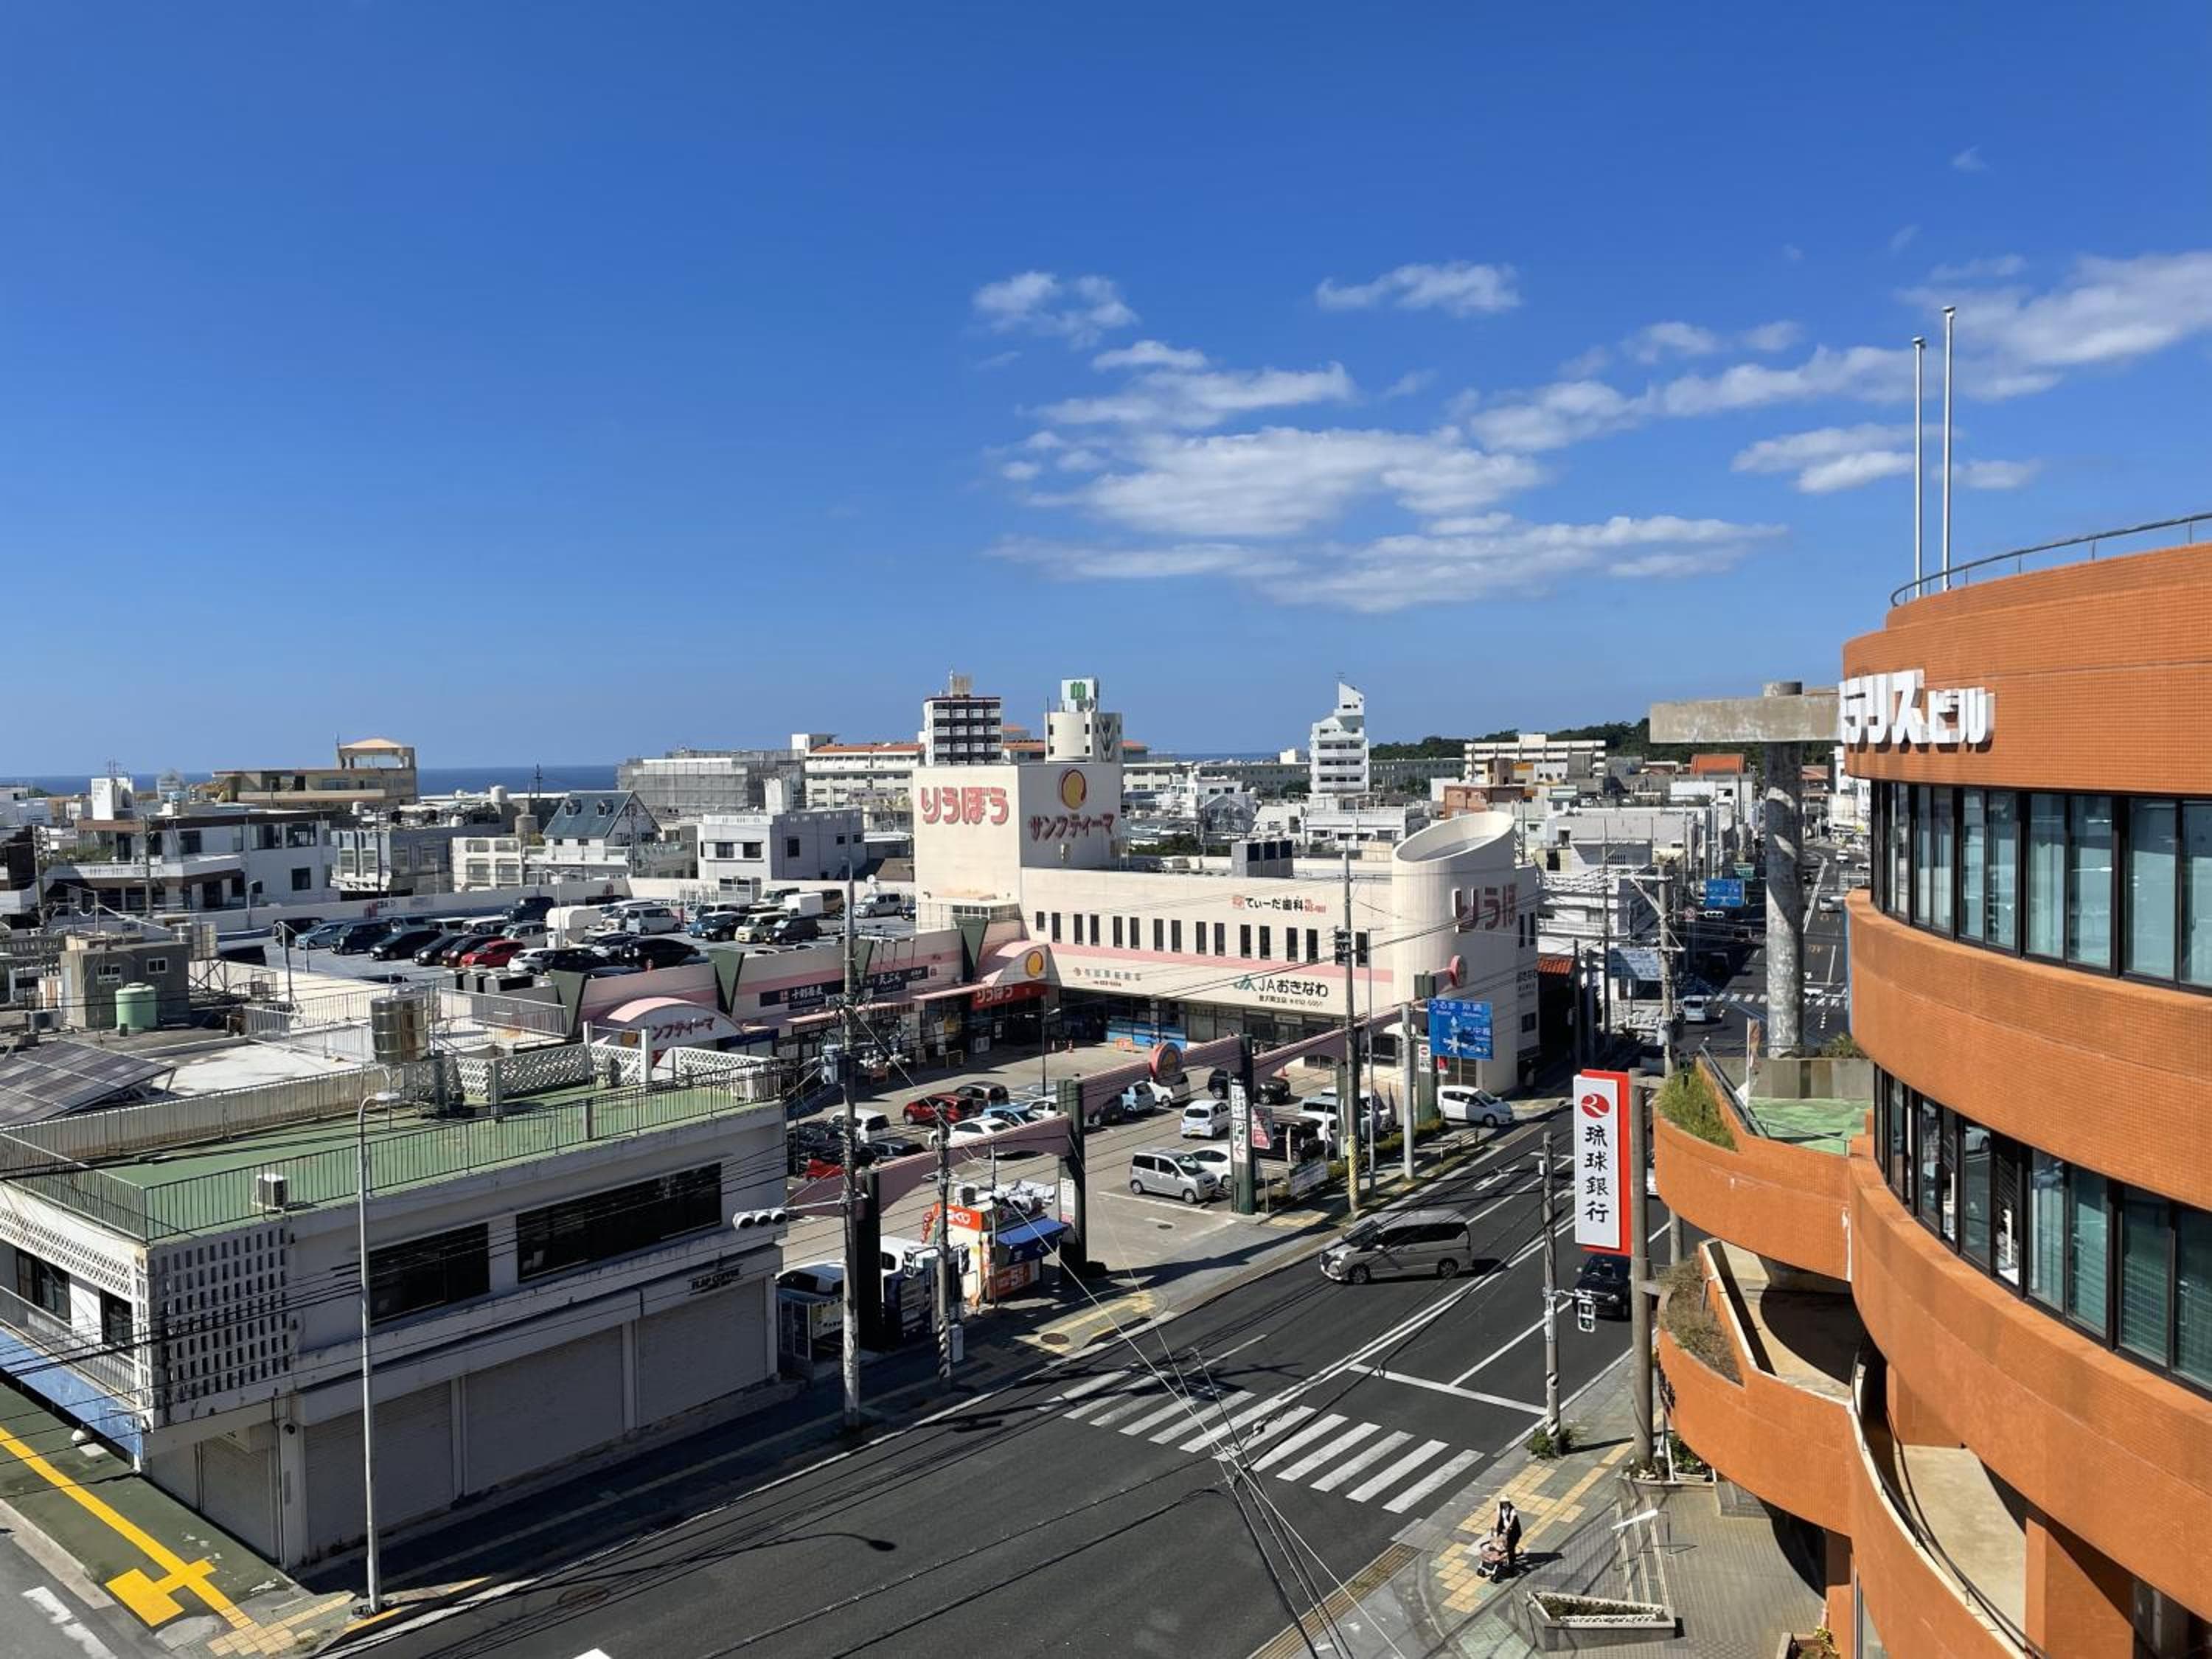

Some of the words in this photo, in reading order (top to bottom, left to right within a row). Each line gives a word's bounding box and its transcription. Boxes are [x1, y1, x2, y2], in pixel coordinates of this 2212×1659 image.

[920, 787, 1009, 826] りうぼう
[1245, 896, 1304, 911] てぃーだ歯科
[976, 986, 1014, 1004] りうぼう
[1259, 978, 1329, 998] JAおきなわ
[1430, 1001, 1456, 1009] うるま
[1584, 1124, 1610, 1224] 琉球銀行
